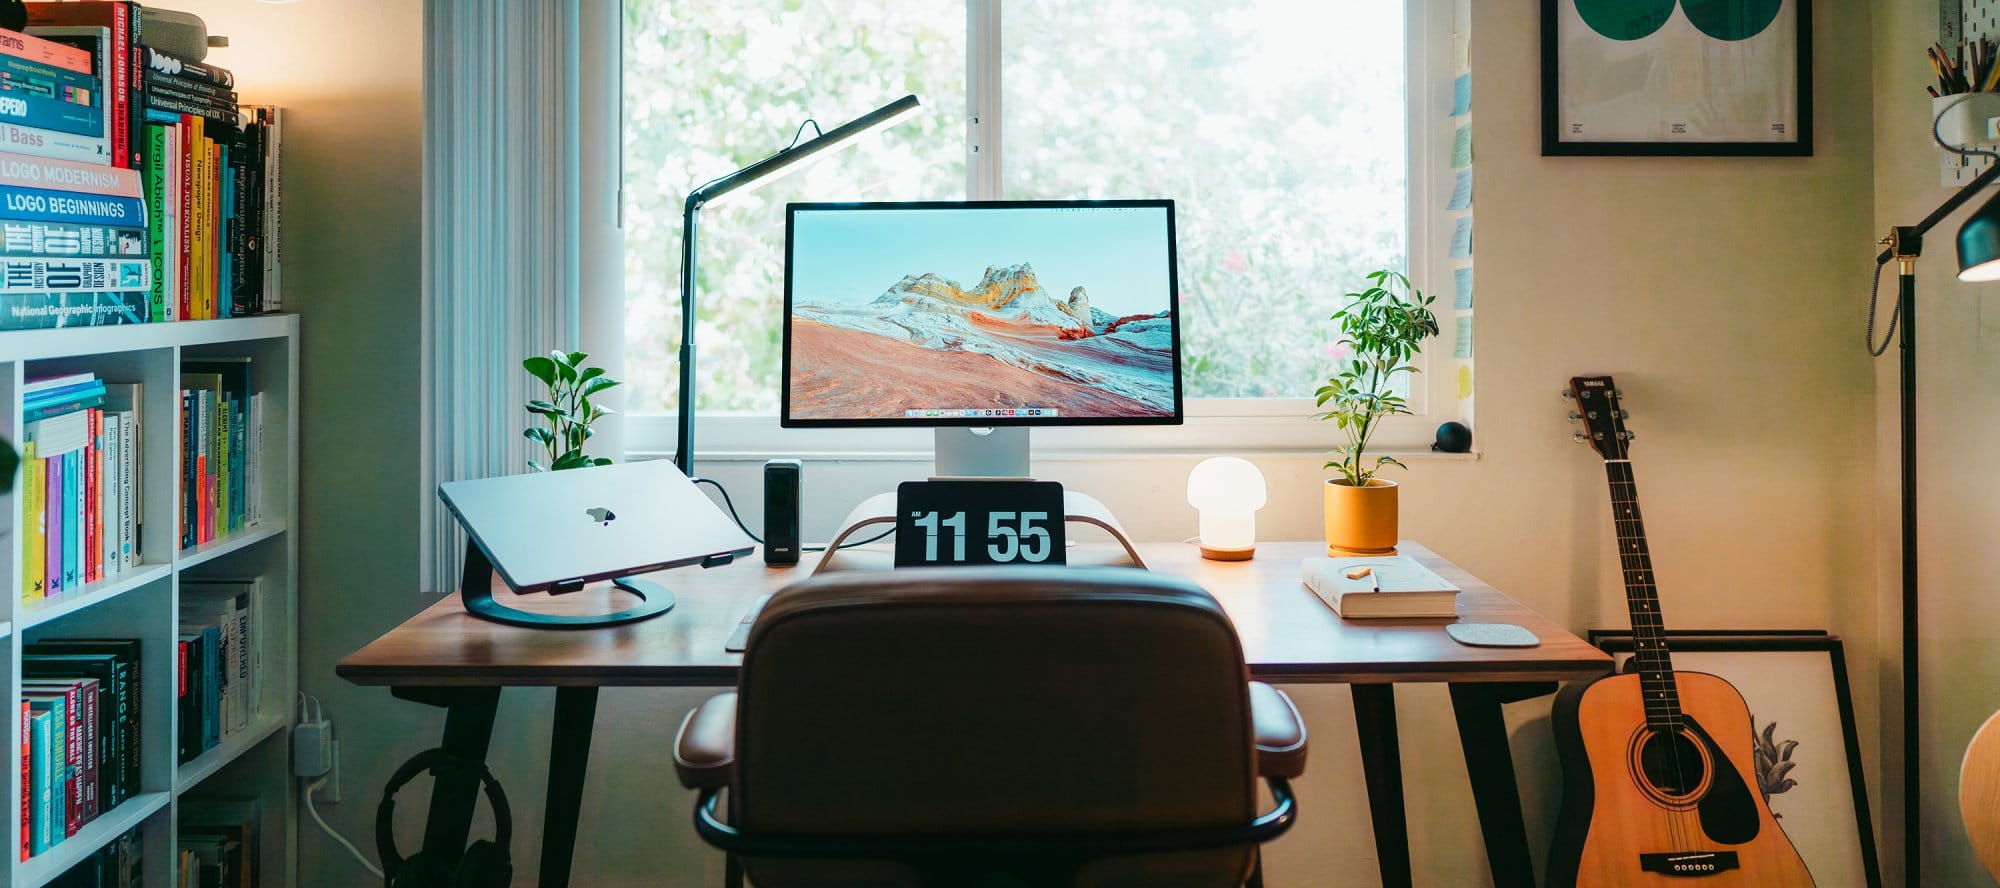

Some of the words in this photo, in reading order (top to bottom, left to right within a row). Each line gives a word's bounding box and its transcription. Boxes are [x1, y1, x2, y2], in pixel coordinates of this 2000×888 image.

[117, 7, 125, 51] MICHAEL
[117, 54, 125, 101] JOHNSON
[152, 73, 172, 82] Universal
[0, 96, 28, 117] EPERO
[150, 96, 178, 109] Universal
[178, 102, 205, 117] Principles
[205, 109, 212, 117] of
[211, 110, 221, 119] UX
[11, 127, 44, 147] Bass
[153, 132, 164, 170] Virgil
[1, 160, 41, 180] LOGO
[43, 165, 120, 189] MODERNISM
[195, 159, 203, 209] Newspaper
[6, 193, 46, 213] LOGO
[48, 196, 125, 218] BEGINNINGS
[183, 189, 191, 253] JOURNALISM
[194, 212, 202, 242] Design
[4, 223, 33, 253] THE
[44, 225, 81, 254] OF
[7, 261, 33, 288] THE
[33, 261, 45, 289] HISTORY
[45, 261, 81, 288] OF
[82, 262, 93, 288] GRAPHIC
[93, 262, 105, 288] DESIGN
[154, 252, 163, 305] ICONS
[11, 305, 48, 317] National
[48, 303, 93, 317] Geographic
[93, 302, 136, 316] Infographics
[914, 511, 966, 561] 11
[987, 511, 1051, 563] 55
[119, 670, 127, 724] RANGE
[55, 703, 65, 730] LISA
[55, 731, 65, 783] RANDALL
